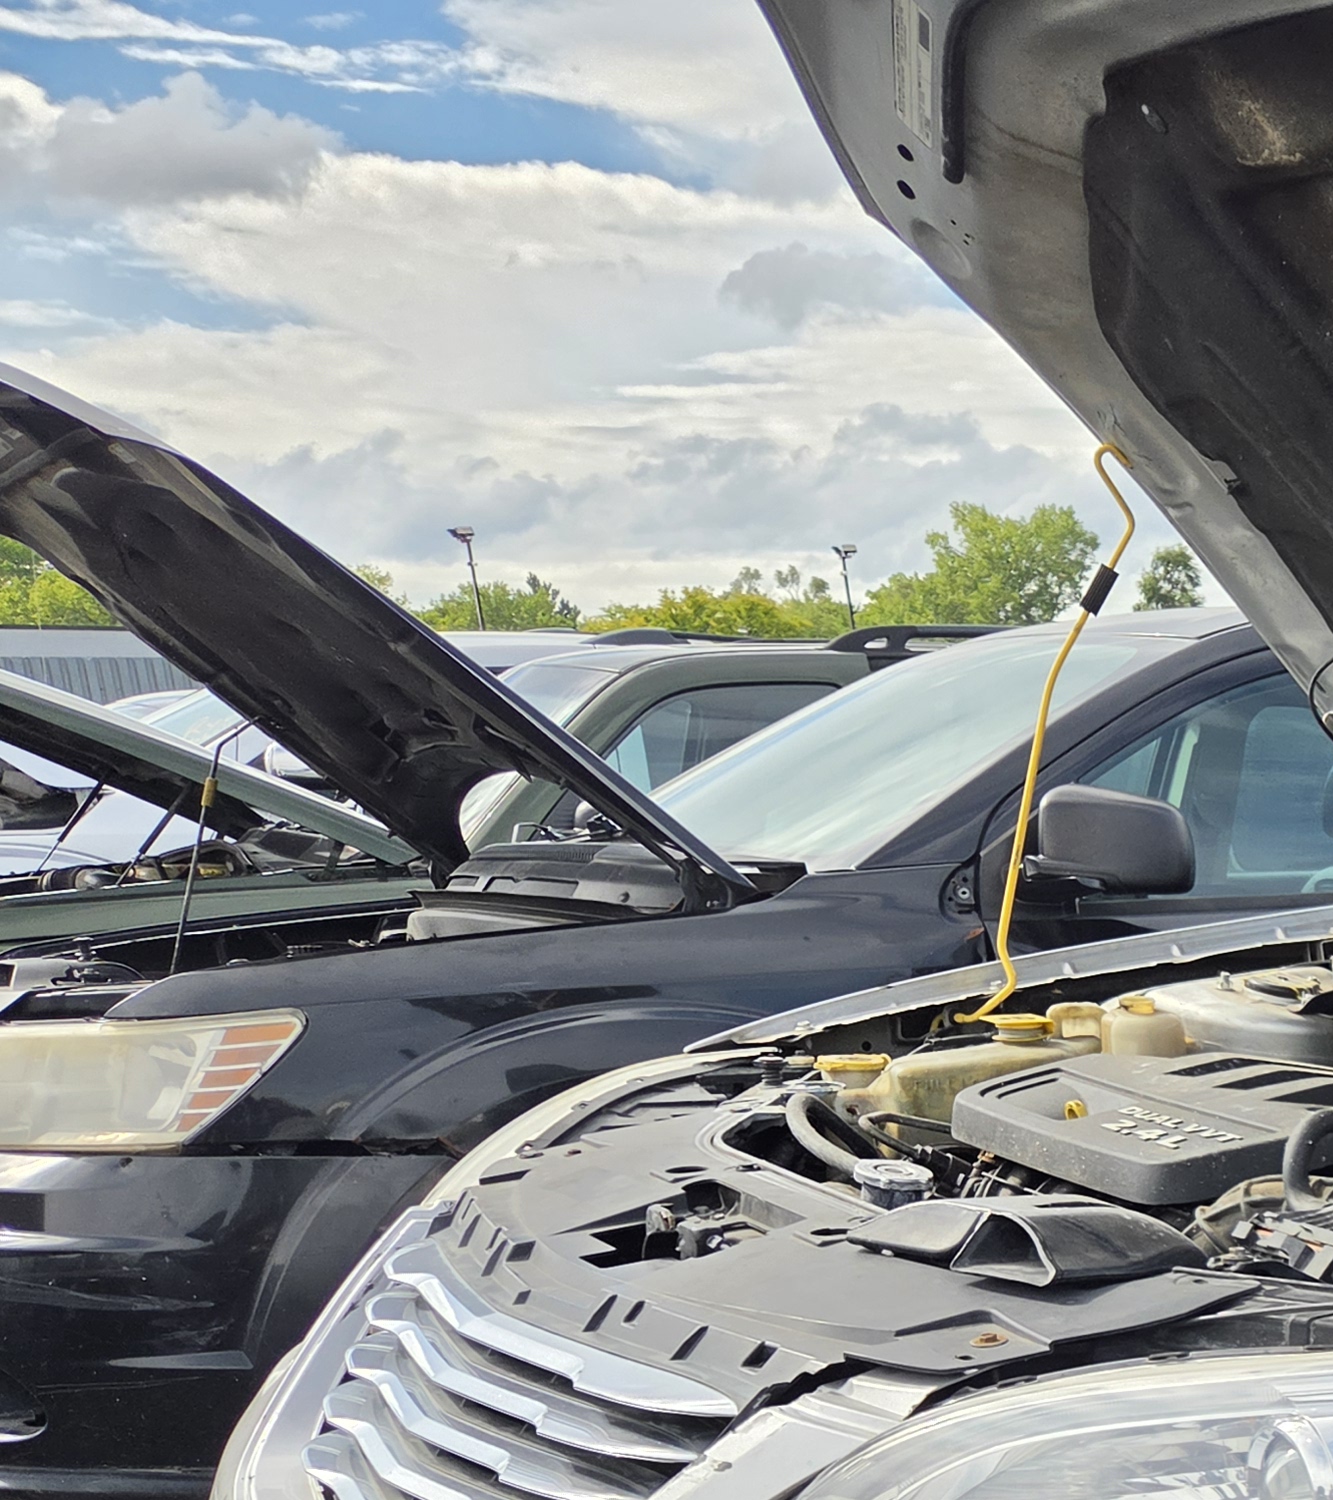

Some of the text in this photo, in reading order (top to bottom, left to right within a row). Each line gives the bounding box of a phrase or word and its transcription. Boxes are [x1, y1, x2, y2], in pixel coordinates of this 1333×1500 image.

[1100, 1118, 1189, 1150] 2.4L
[1117, 1105, 1245, 1144] DUAL VVT
